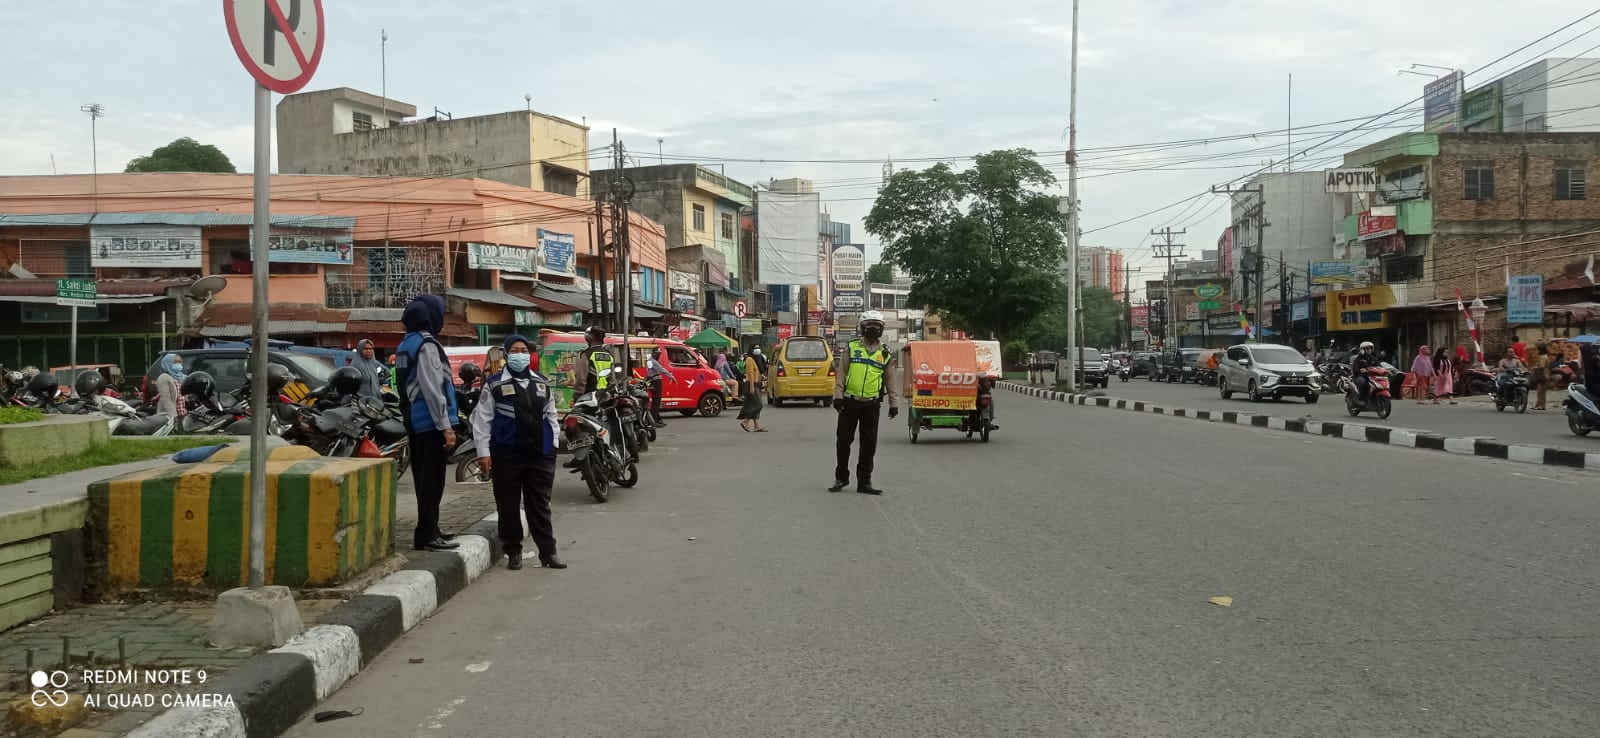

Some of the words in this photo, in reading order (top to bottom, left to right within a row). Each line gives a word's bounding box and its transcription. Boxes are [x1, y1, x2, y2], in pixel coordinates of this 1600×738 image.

[264, 0, 300, 66] P
[1327, 171, 1375, 186] APOTIK
[480, 245, 497, 257] TOP
[499, 246, 528, 261] TAILOR
[937, 372, 977, 385] COD
